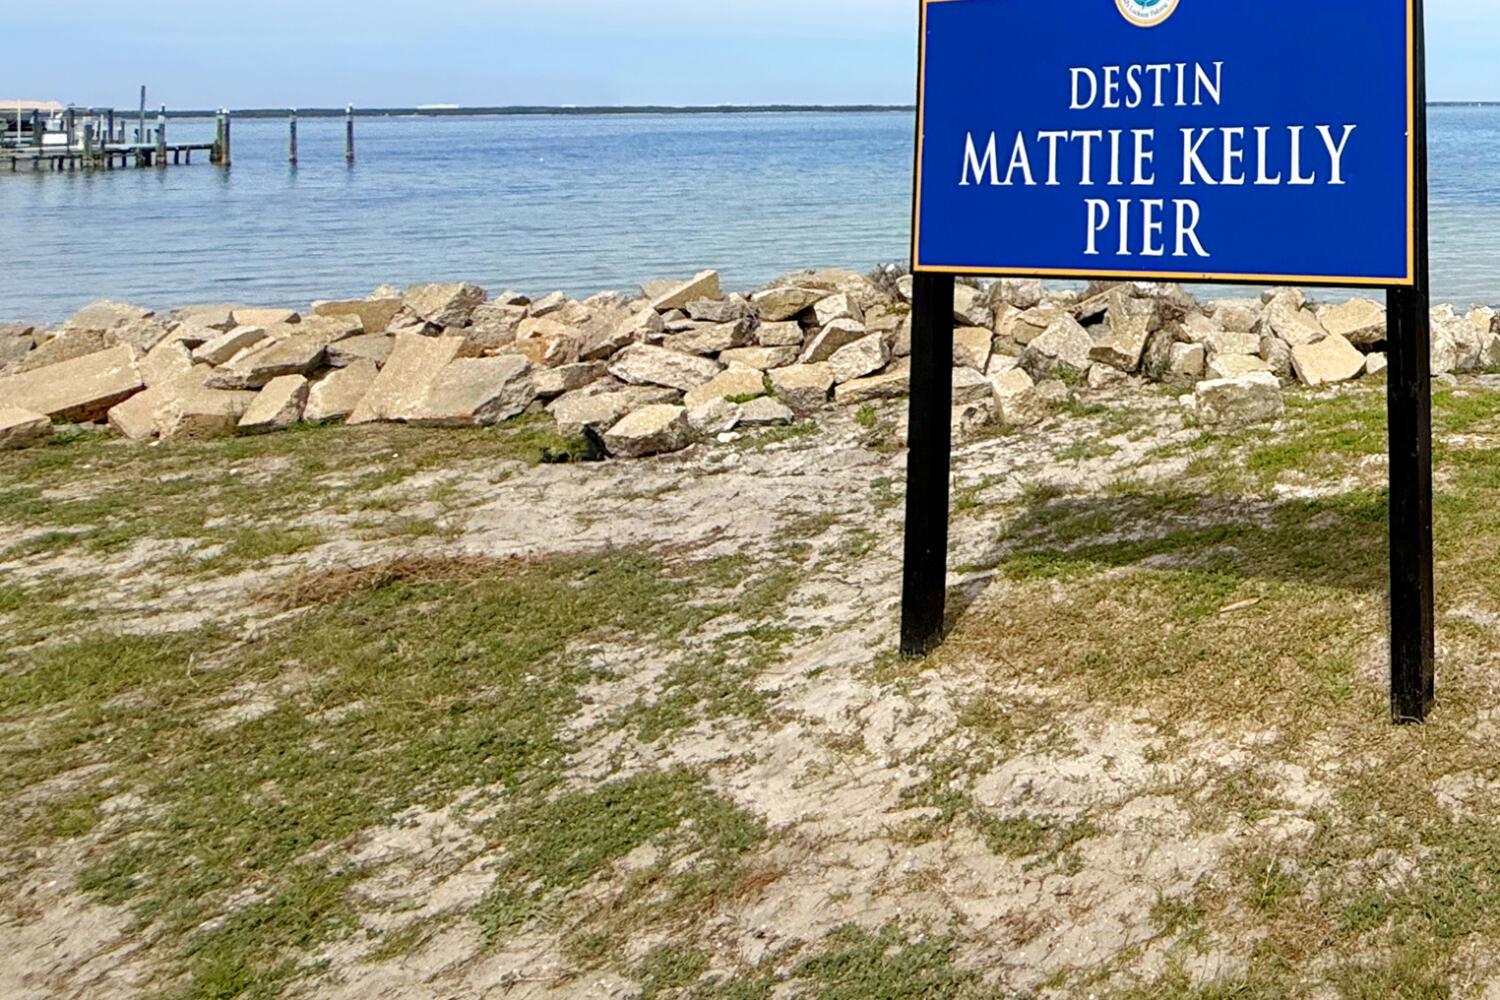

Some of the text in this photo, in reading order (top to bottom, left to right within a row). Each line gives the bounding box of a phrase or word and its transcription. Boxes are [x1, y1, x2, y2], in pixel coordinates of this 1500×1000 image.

[1069, 61, 1224, 110] DESTIN
[958, 124, 1357, 186] MATTIE KELLY
[1083, 198, 1210, 257] PIER
